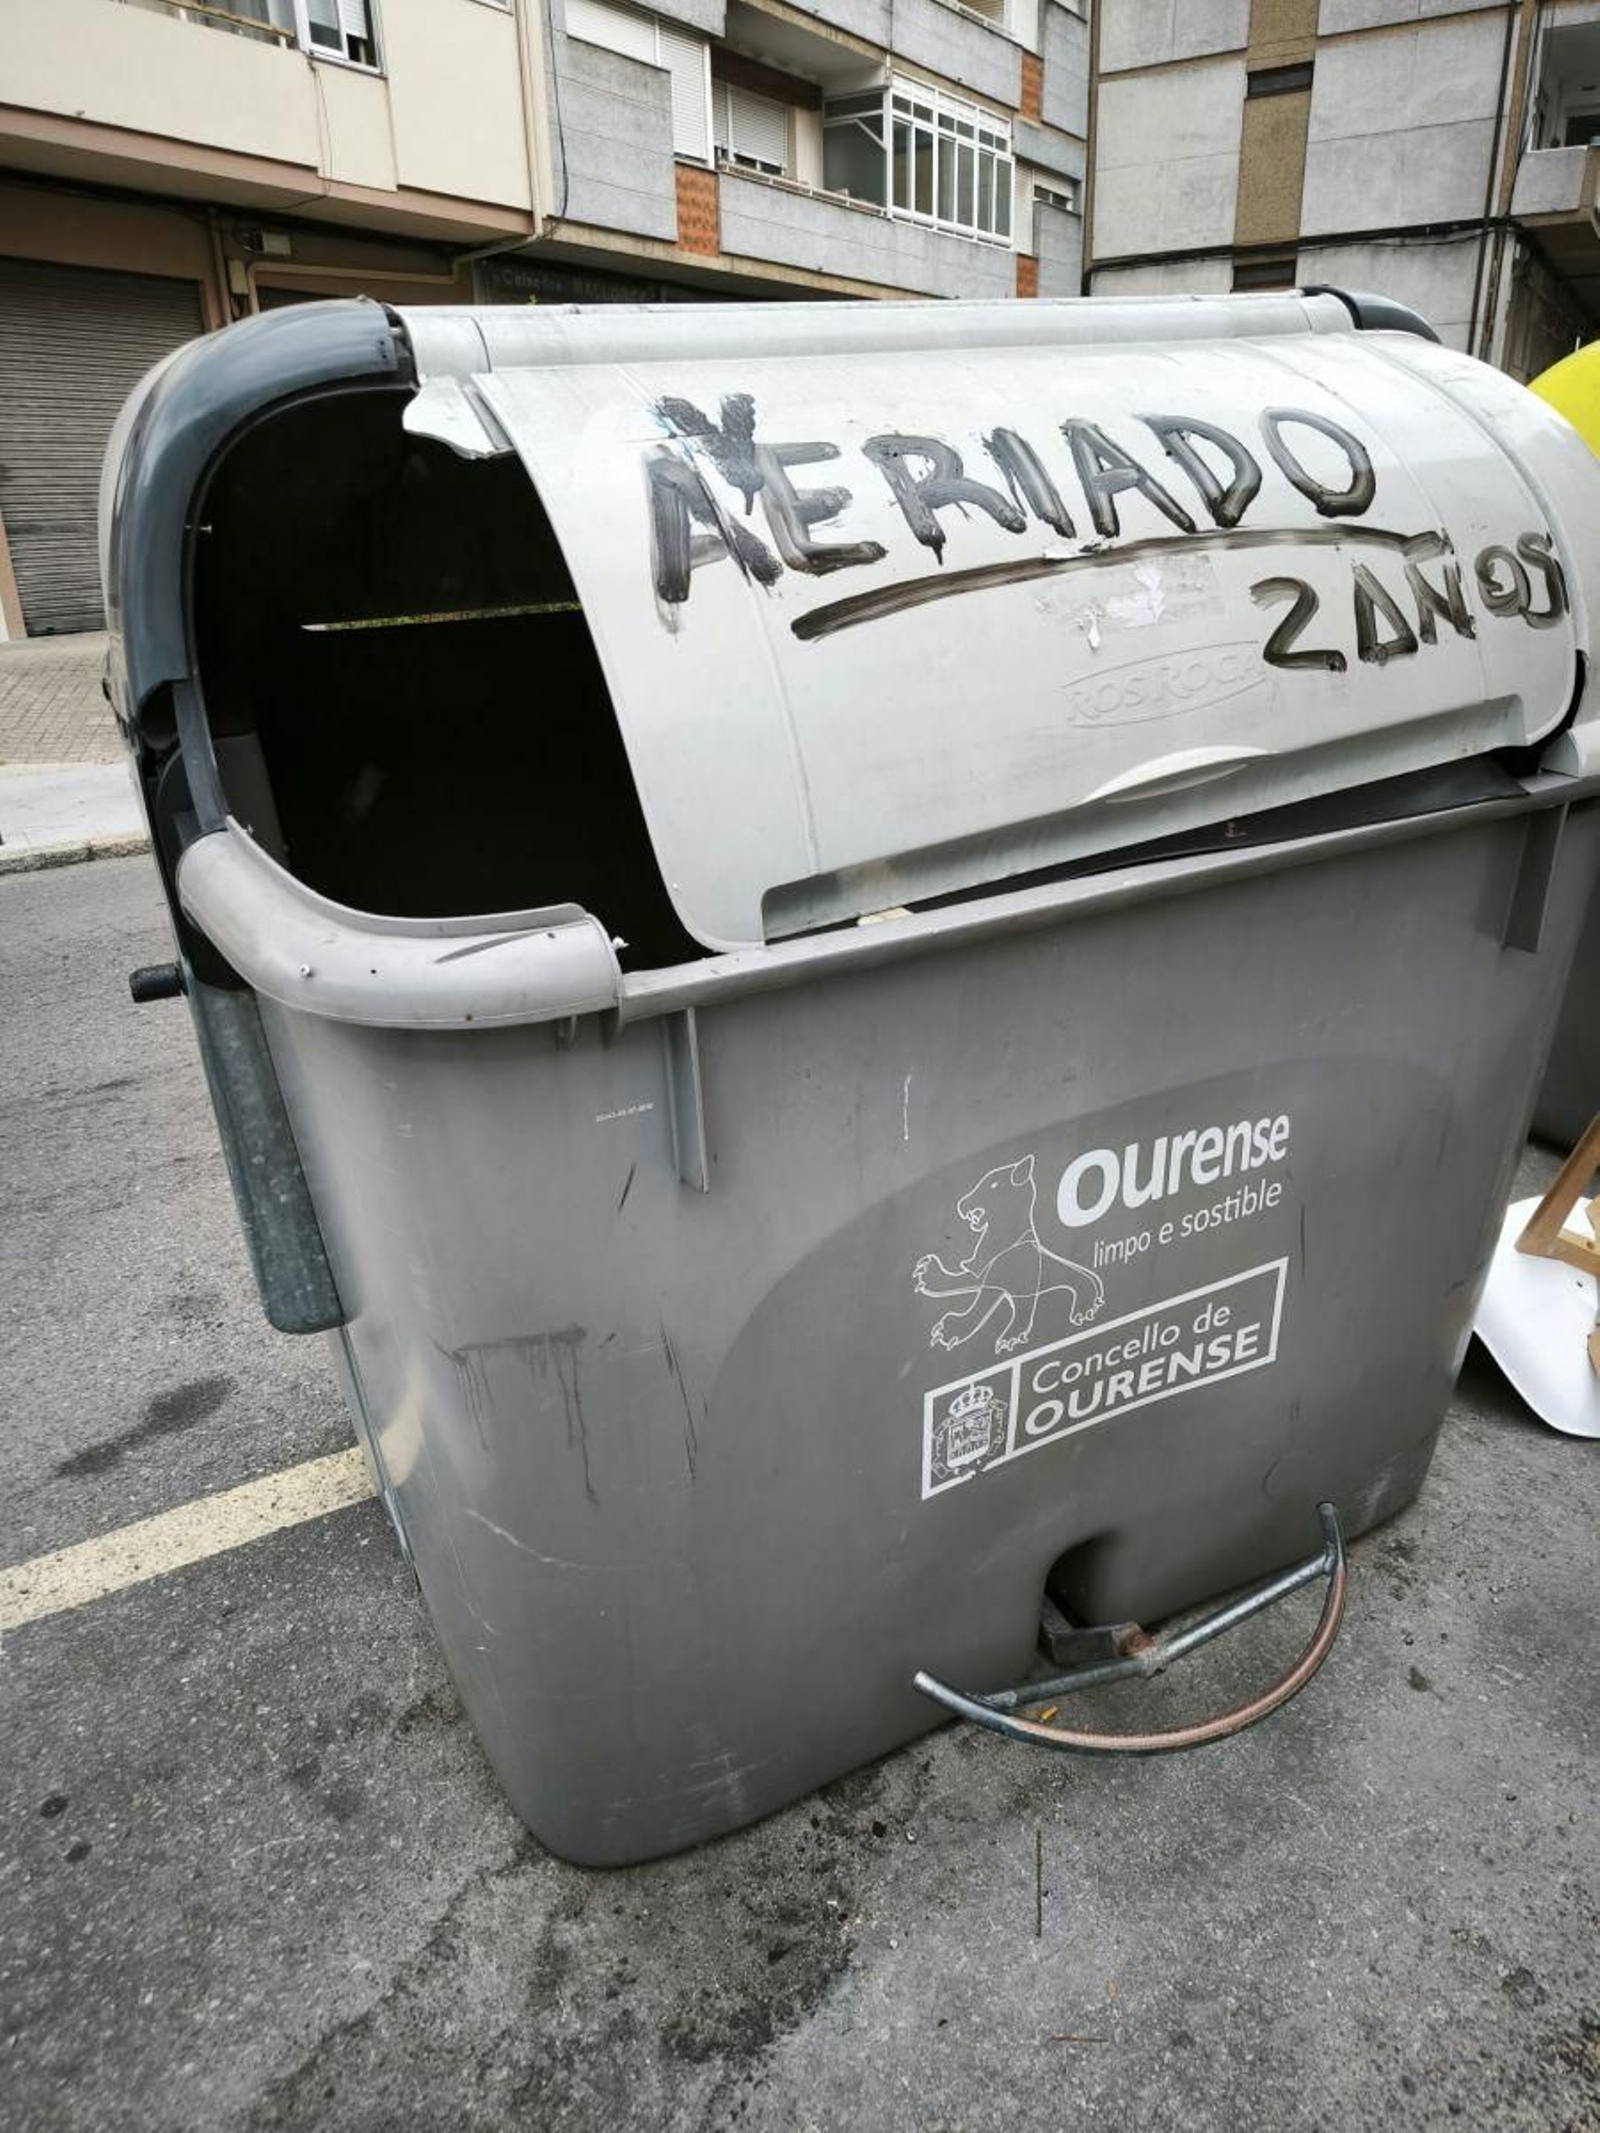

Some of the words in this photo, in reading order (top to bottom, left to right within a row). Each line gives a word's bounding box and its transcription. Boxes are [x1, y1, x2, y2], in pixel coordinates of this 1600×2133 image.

[1249, 576, 1347, 672] 2
[1056, 1113, 1290, 1228] Ourense
[1093, 1231, 1151, 1268] limpo
[1159, 1219, 1174, 1245] e
[1180, 1178, 1282, 1238] sostible
[1024, 1321, 1261, 1436] OURENSE
[1031, 1321, 1181, 1394] Concello
[1193, 1302, 1231, 1335] de
